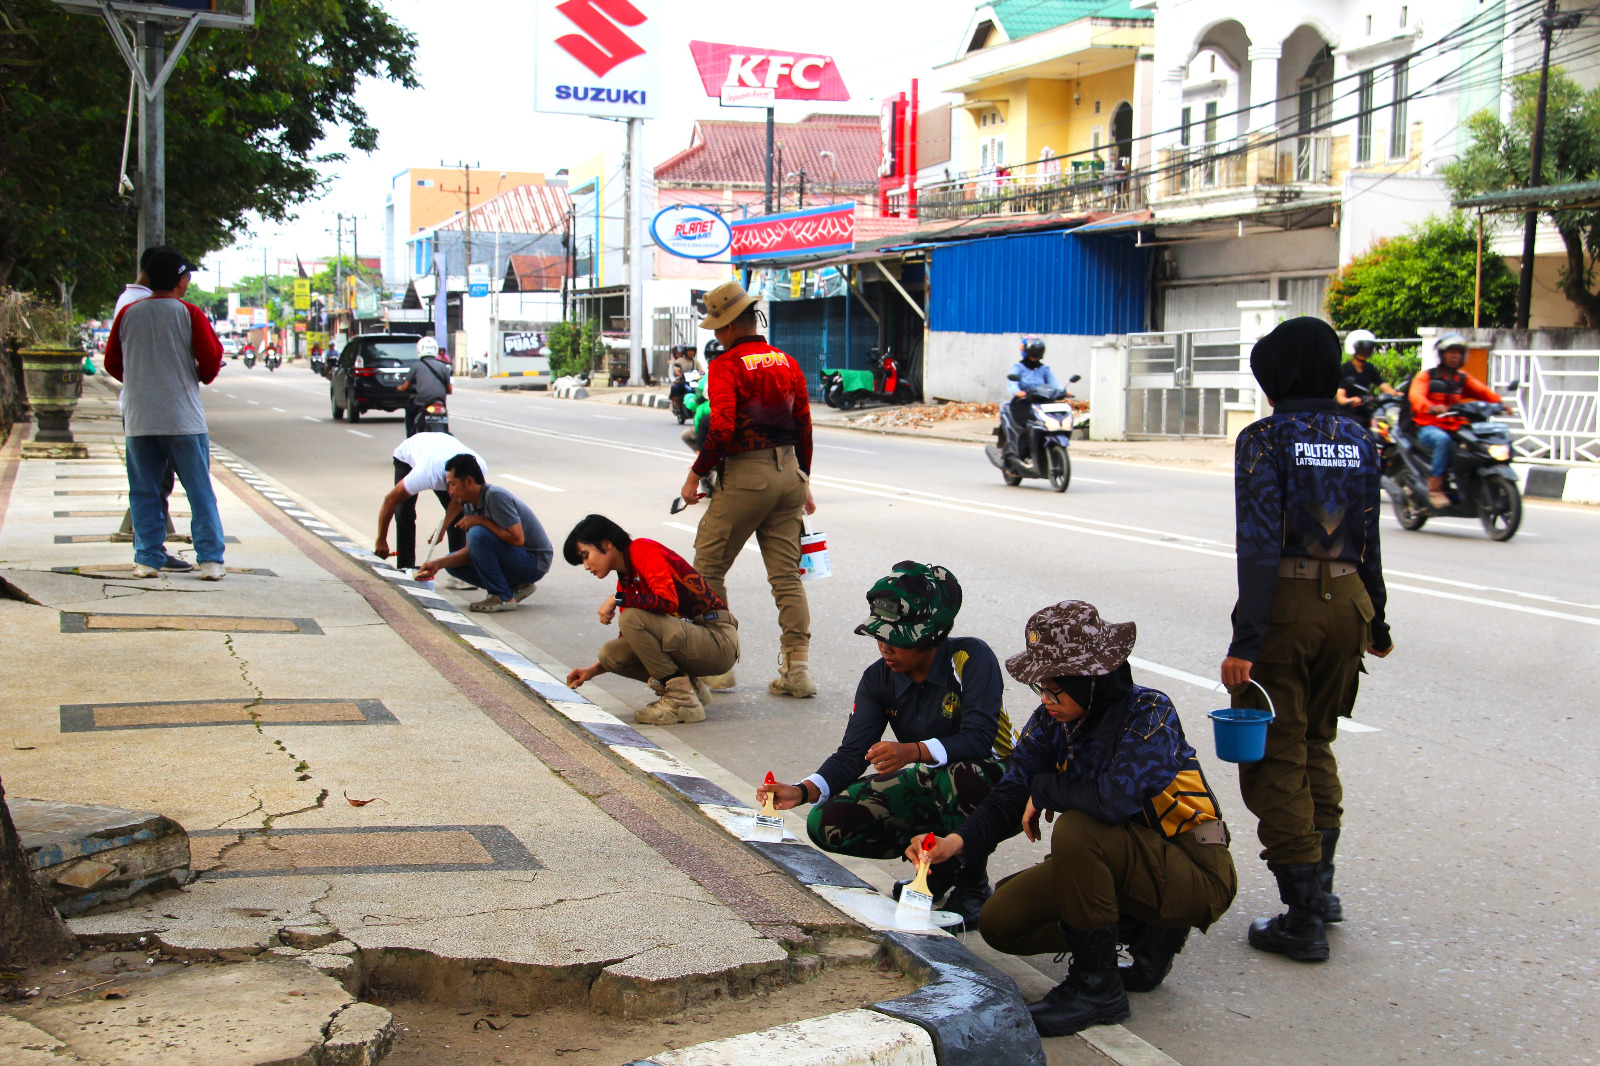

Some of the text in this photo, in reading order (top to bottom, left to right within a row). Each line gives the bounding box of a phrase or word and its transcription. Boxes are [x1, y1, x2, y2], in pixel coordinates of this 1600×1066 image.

[722, 54, 826, 90] KFC
[555, 85, 646, 105] SUZUKI
[674, 220, 715, 236] PLANET
[505, 336, 539, 353] PUAS
[741, 351, 790, 370] IPDN
[1294, 442, 1360, 459] POLTEK SSN
